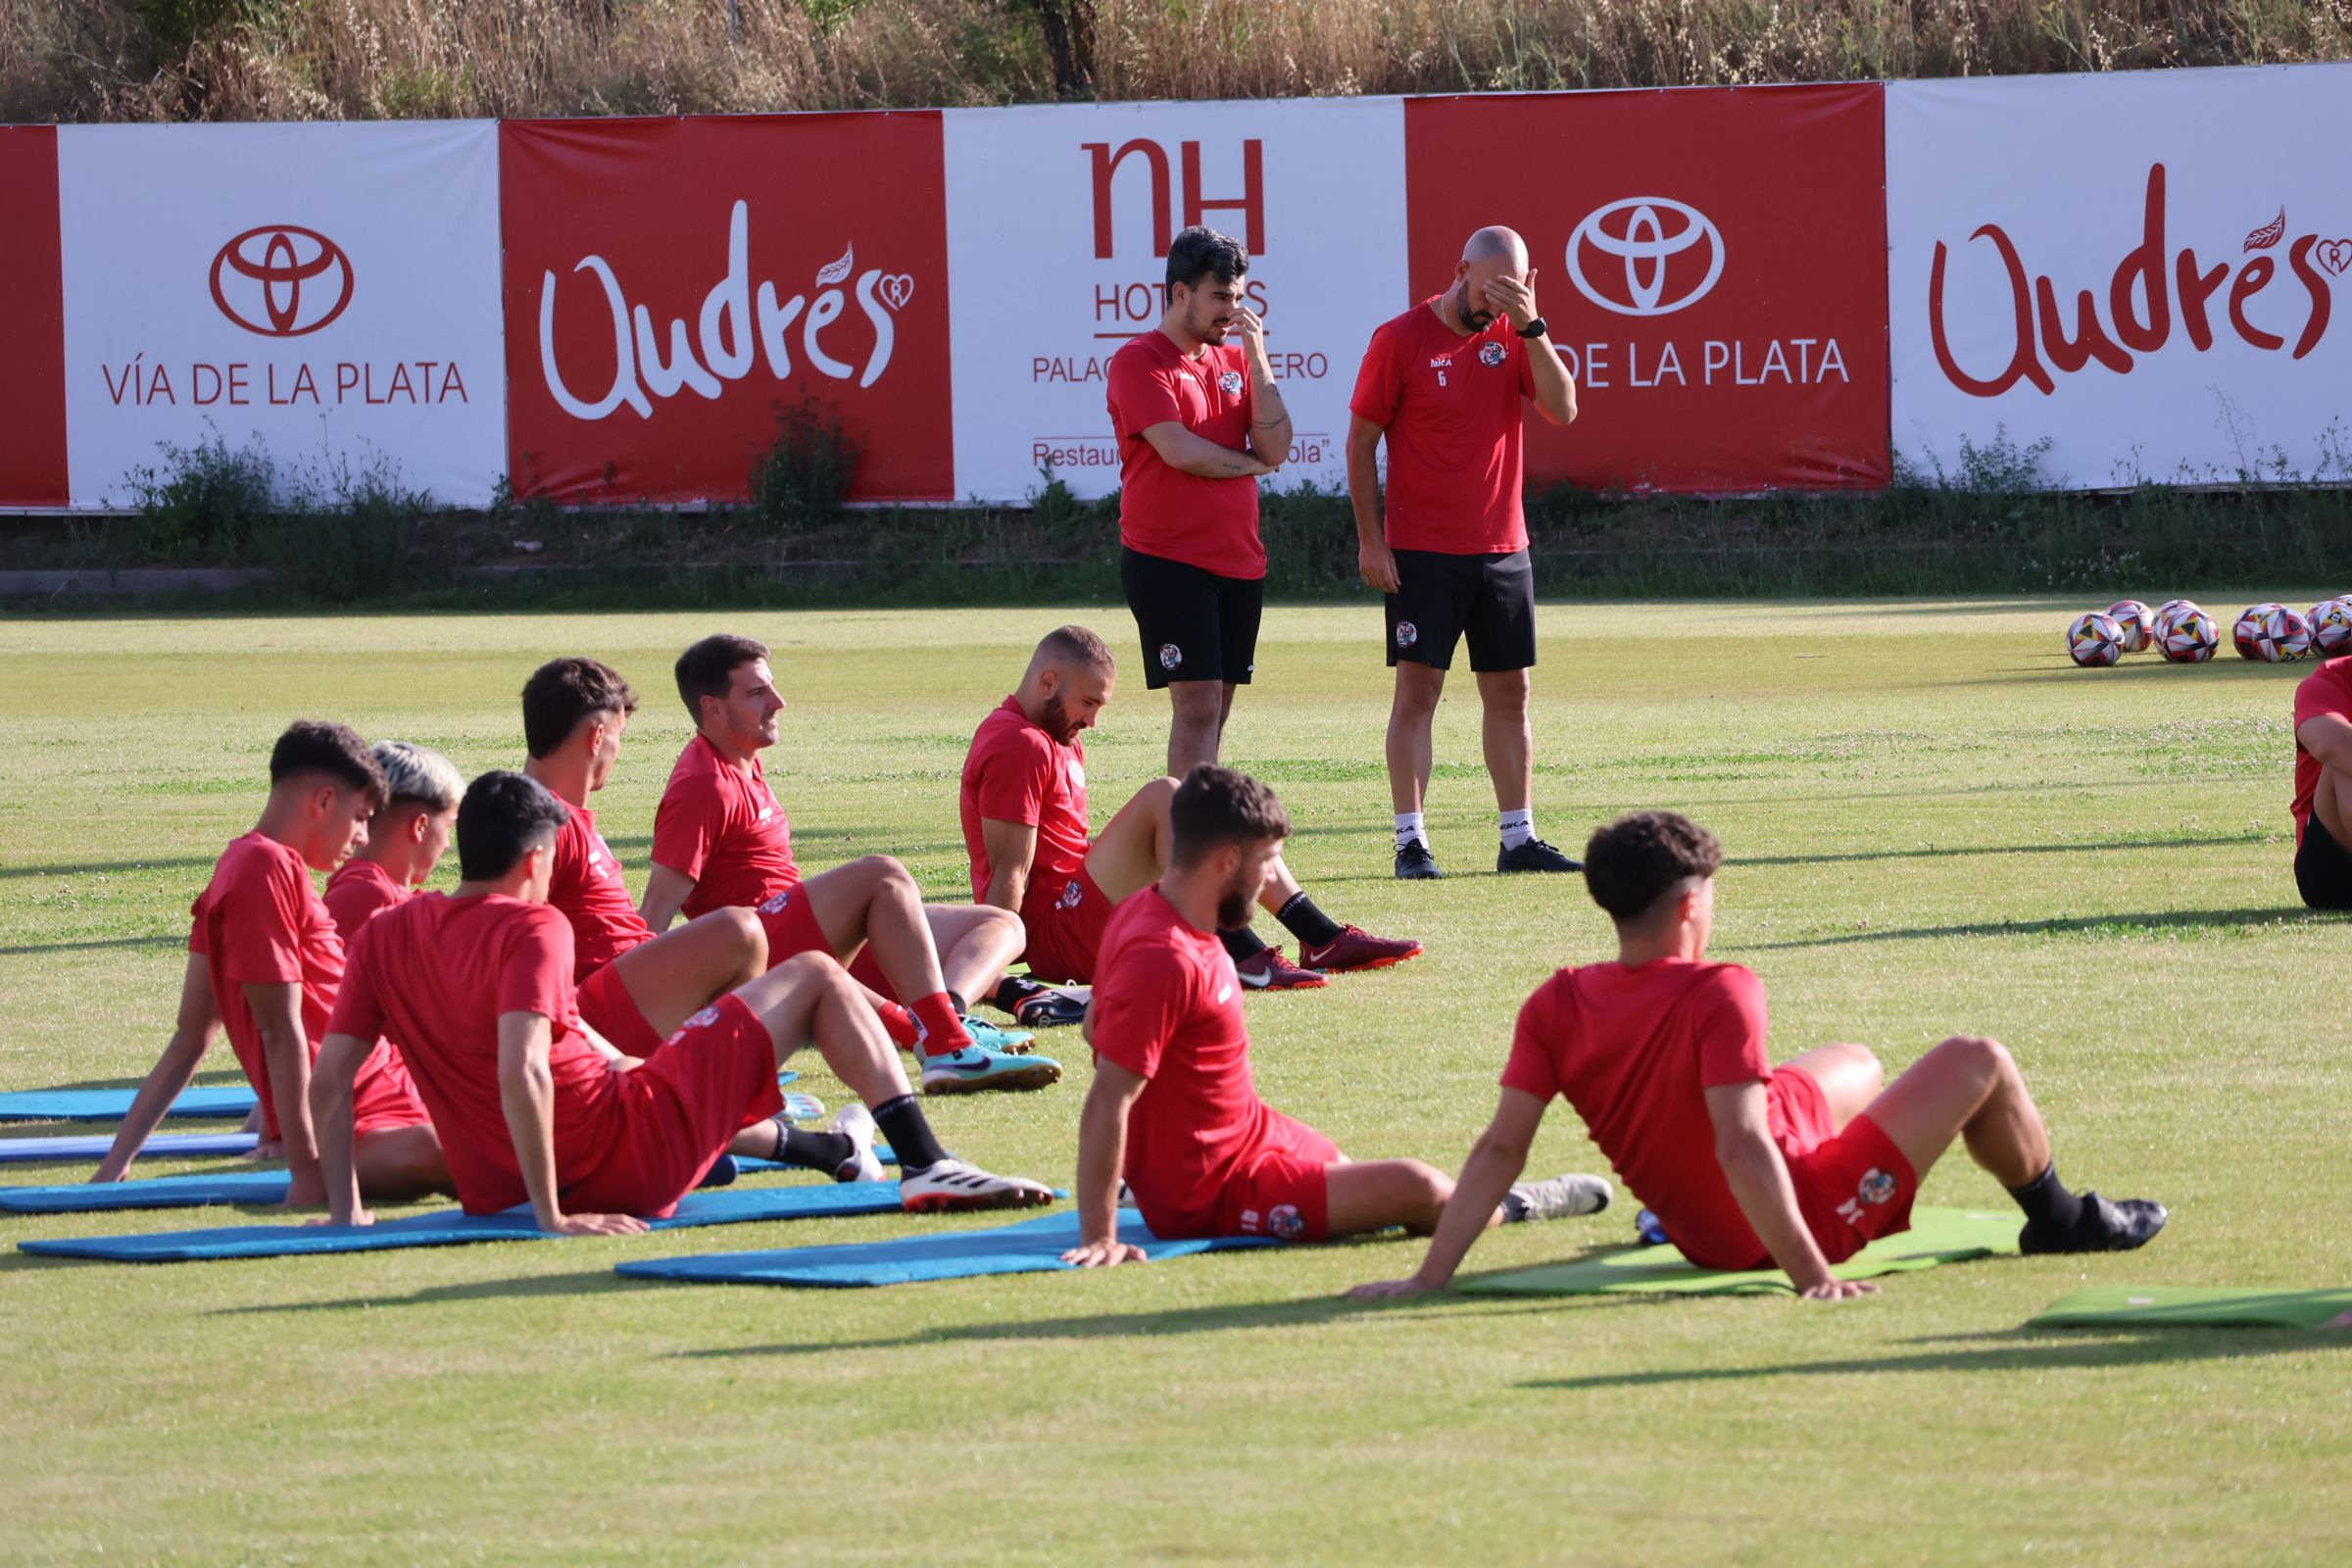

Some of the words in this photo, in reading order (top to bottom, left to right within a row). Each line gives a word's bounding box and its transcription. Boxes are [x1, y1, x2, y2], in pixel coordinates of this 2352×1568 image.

[1096, 280, 1269, 321] HOTS
[102, 352, 175, 406] VÍA
[193, 364, 250, 405] DE
[269, 363, 319, 405] LA
[337, 362, 468, 404] PLATA
[1268, 353, 1328, 378] ERO
[1438, 369, 1447, 387] 6
[1630, 341, 1687, 387] LA
[1705, 338, 1849, 385] PLATA
